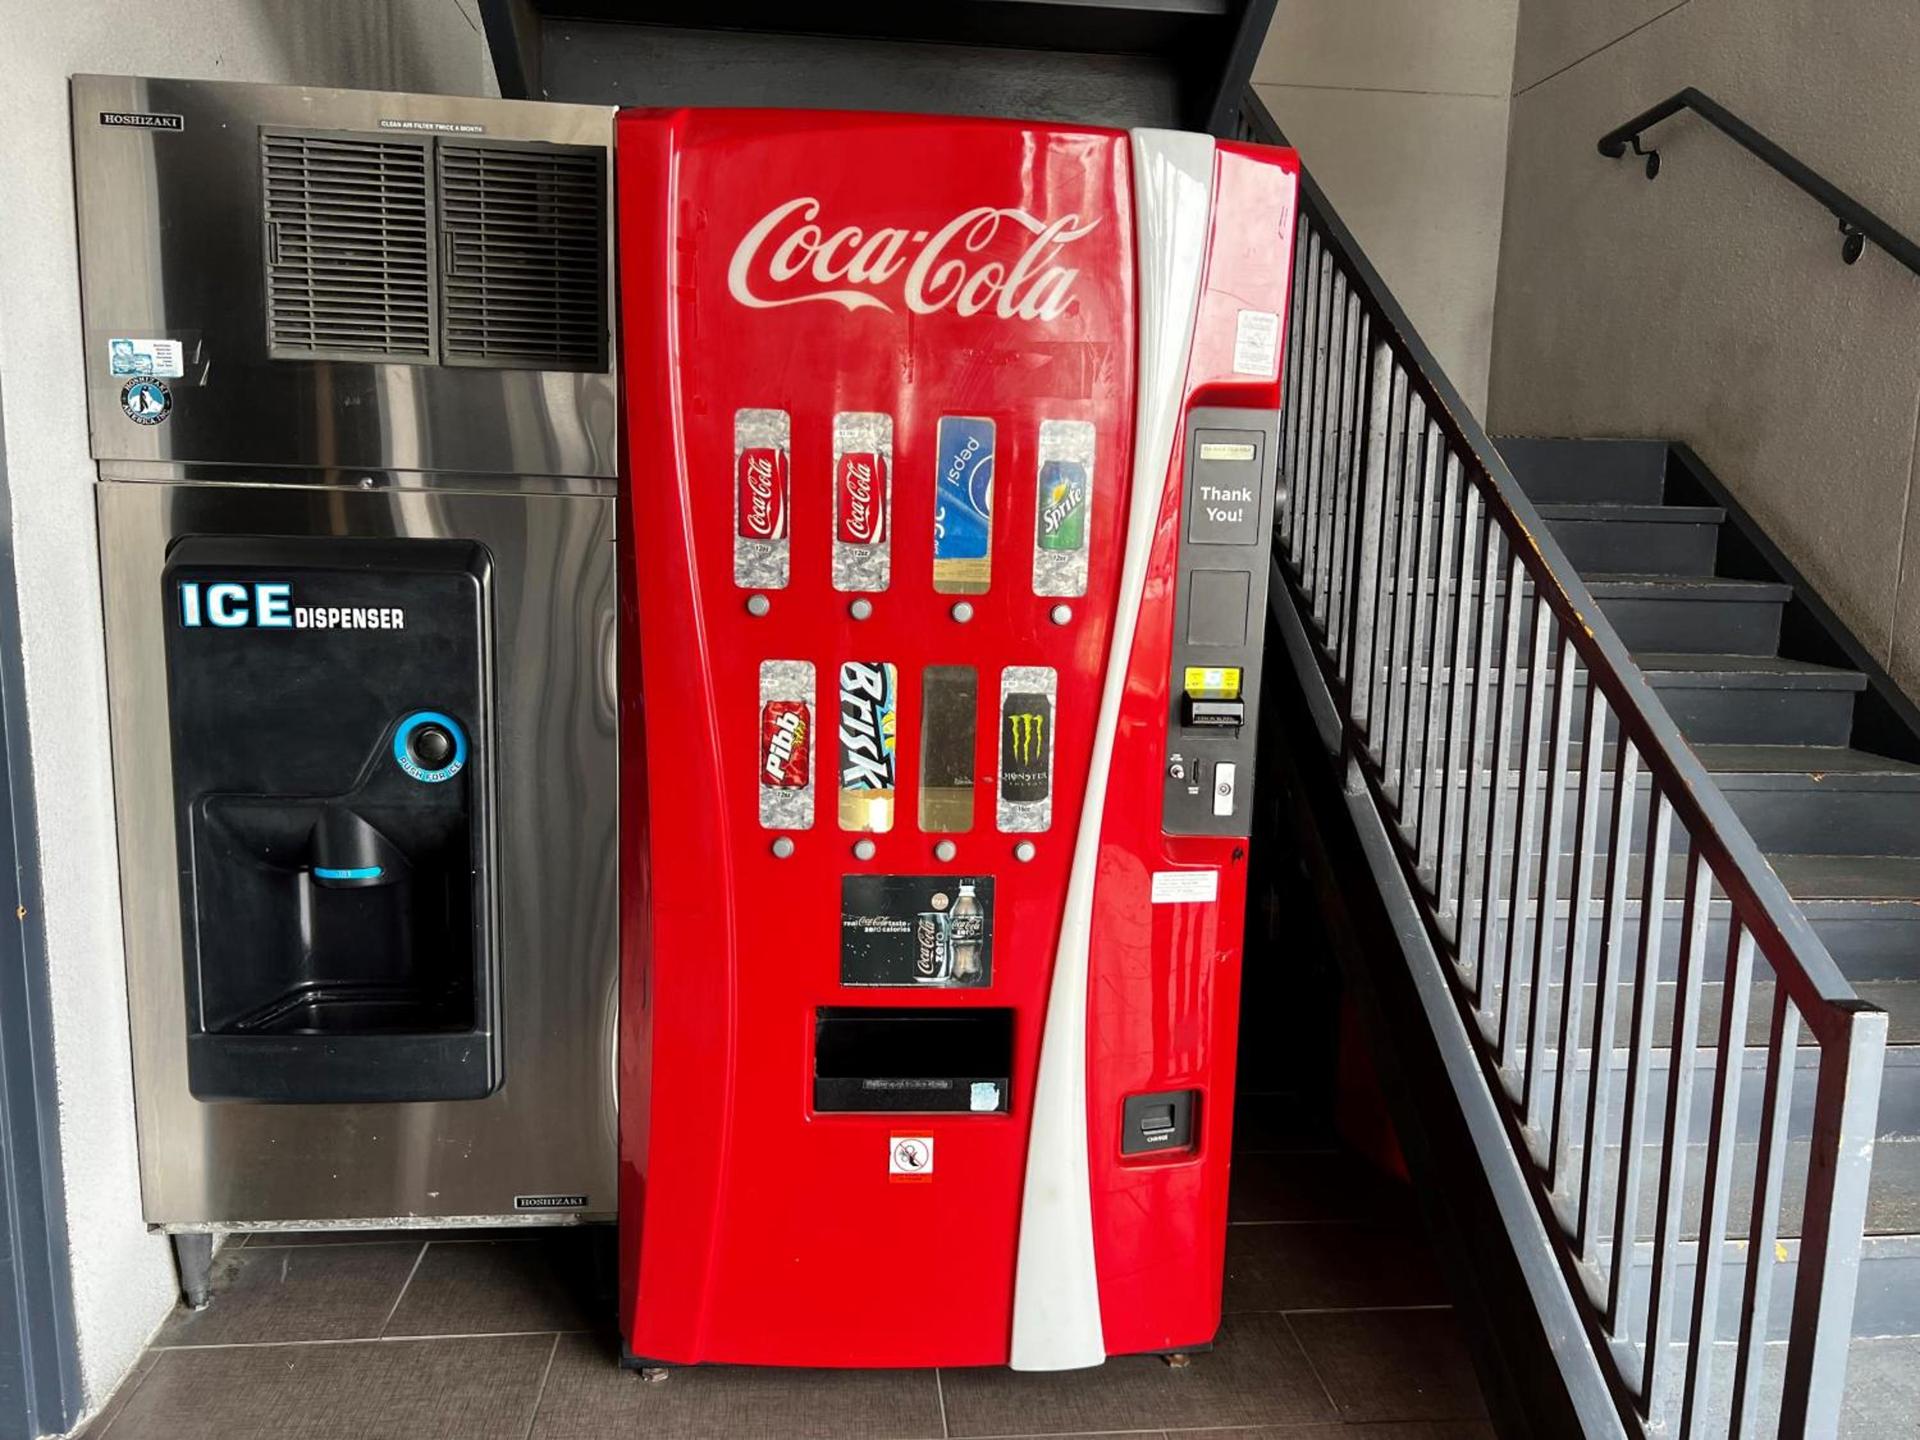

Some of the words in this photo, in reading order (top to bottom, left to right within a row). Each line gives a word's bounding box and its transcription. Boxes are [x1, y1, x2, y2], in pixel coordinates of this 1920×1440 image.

[104, 114, 177, 128] HOSHIZAKI
[381, 120, 401, 128] CLEAN
[403, 121, 412, 129] AIR
[414, 122, 434, 130] FILTER
[728, 197, 1102, 321] Coca-Cola
[947, 436, 980, 487] pepsi
[747, 455, 772, 534] Coca-Cola
[846, 460, 871, 539] Coca-Cola
[1043, 484, 1082, 533] Sprite
[1200, 486, 1252, 502] Thank
[1206, 507, 1243, 522] You!
[181, 583, 293, 628] ICE
[295, 607, 404, 629] DISPENSER
[766, 712, 800, 780] Pibb
[400, 757, 423, 778] PUSH
[425, 772, 446, 780] FOR
[447, 761, 461, 775] ICE
[1003, 772, 1048, 782] MONSTER
[935, 933, 944, 963] zero
[521, 1198, 583, 1206] HOSHIZAKI
